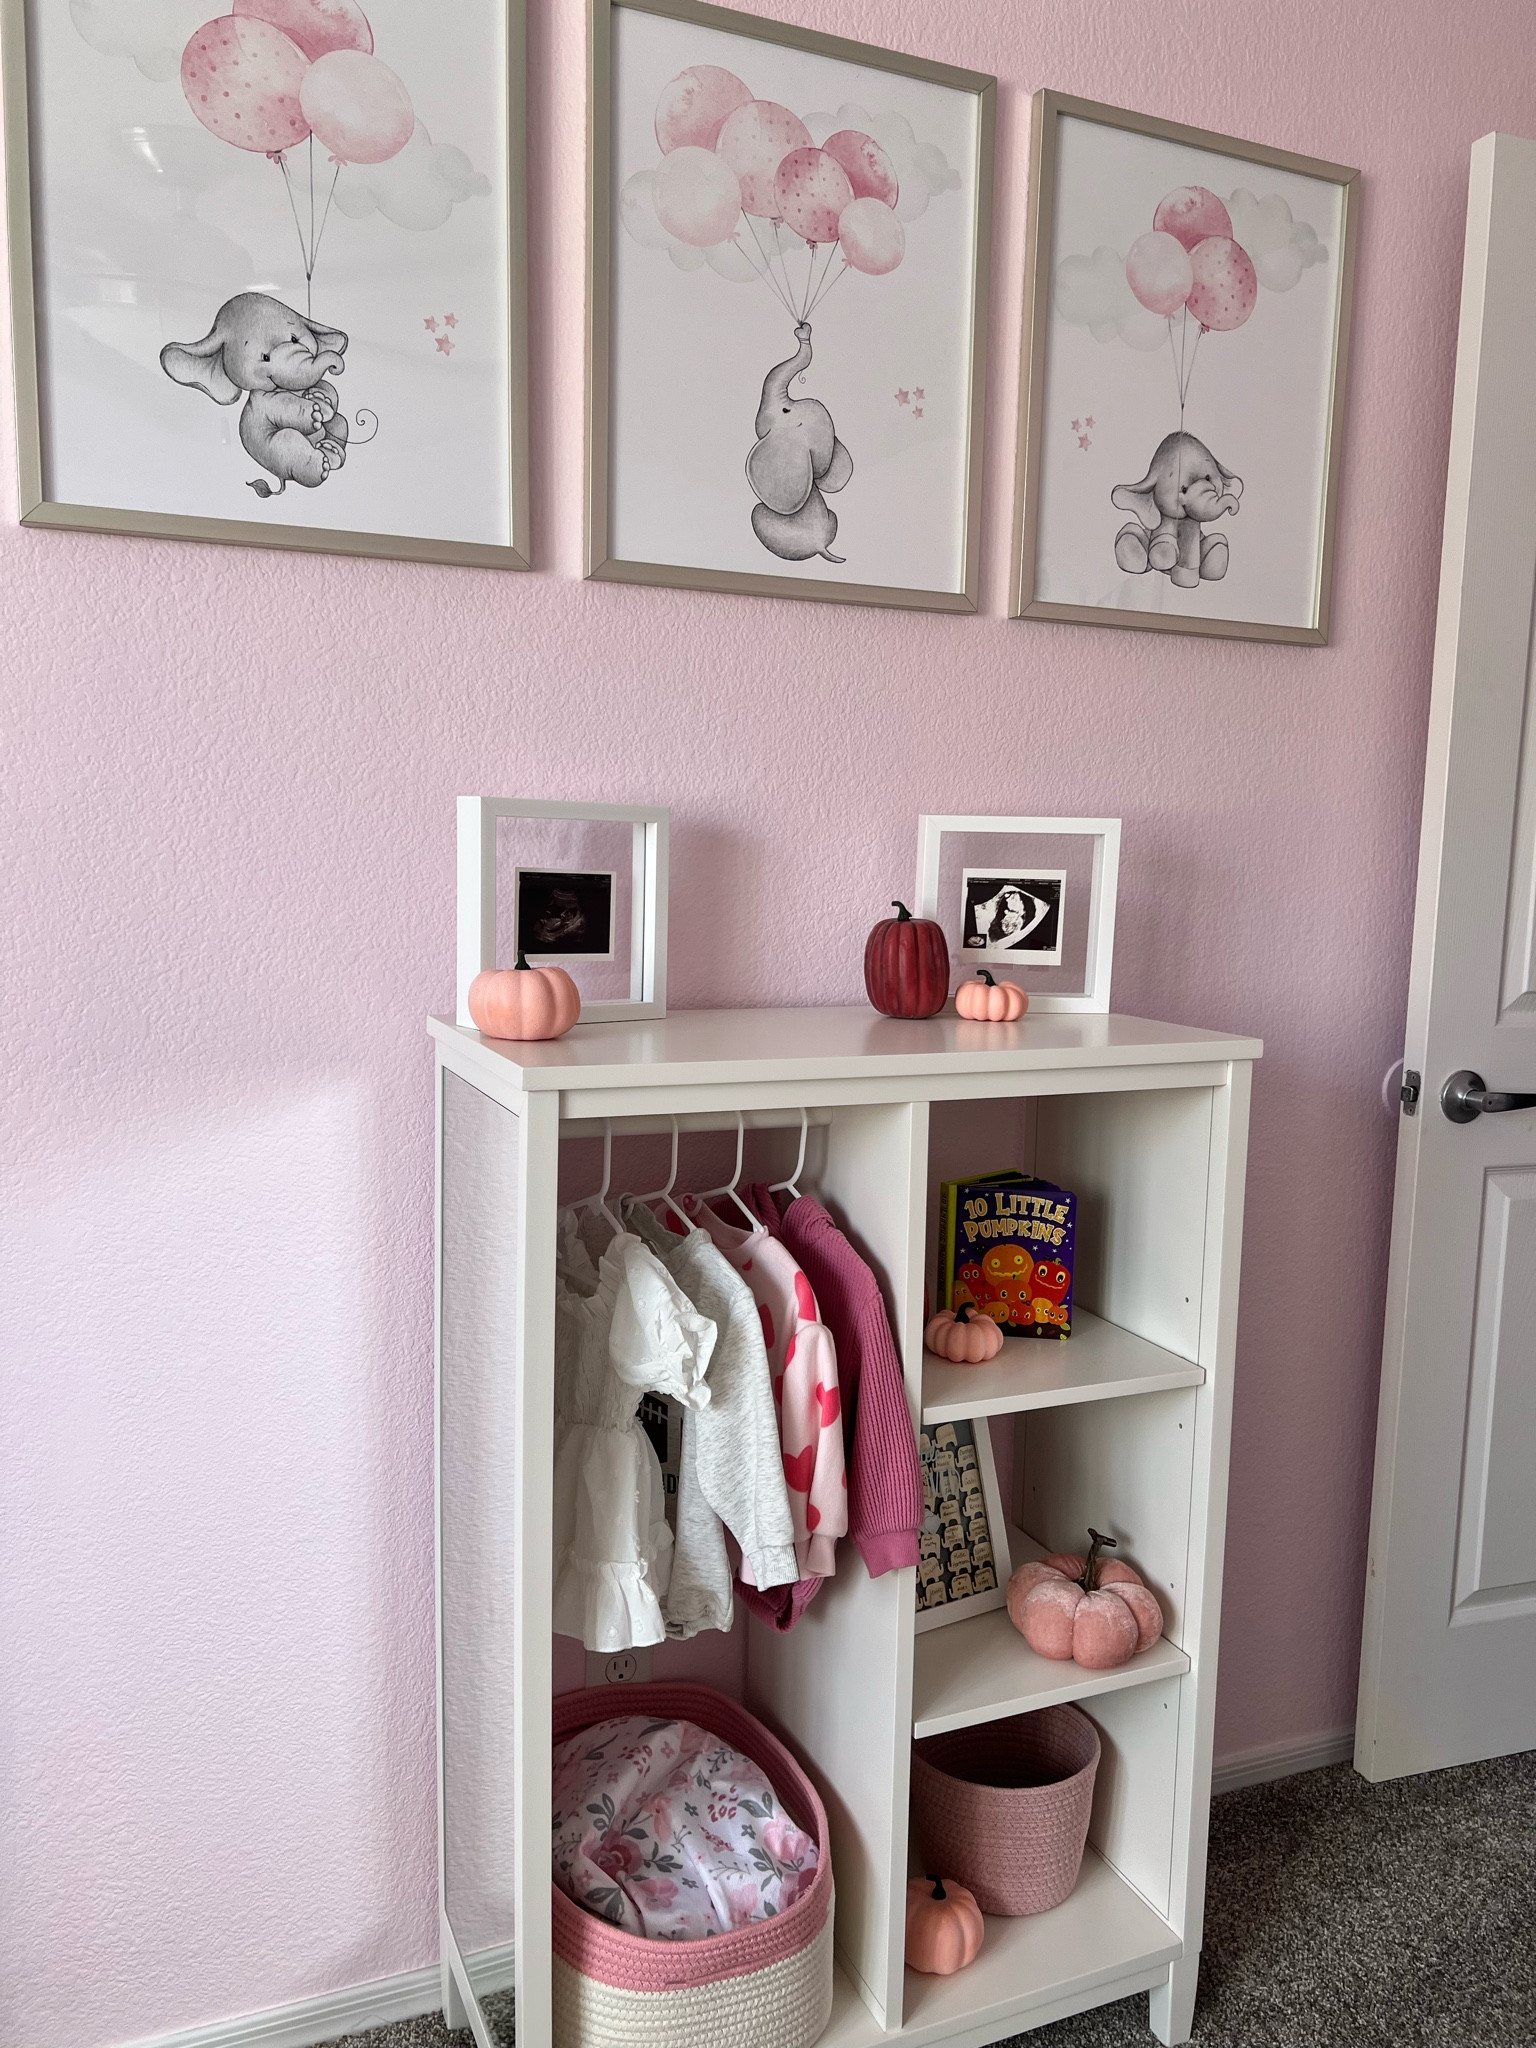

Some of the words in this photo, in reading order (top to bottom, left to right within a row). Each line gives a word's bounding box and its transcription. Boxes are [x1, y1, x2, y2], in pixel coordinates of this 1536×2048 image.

[964, 1197, 988, 1220] 10
[994, 1192, 1070, 1225] LITTLE
[963, 1217, 1067, 1246] PUMPKINS
